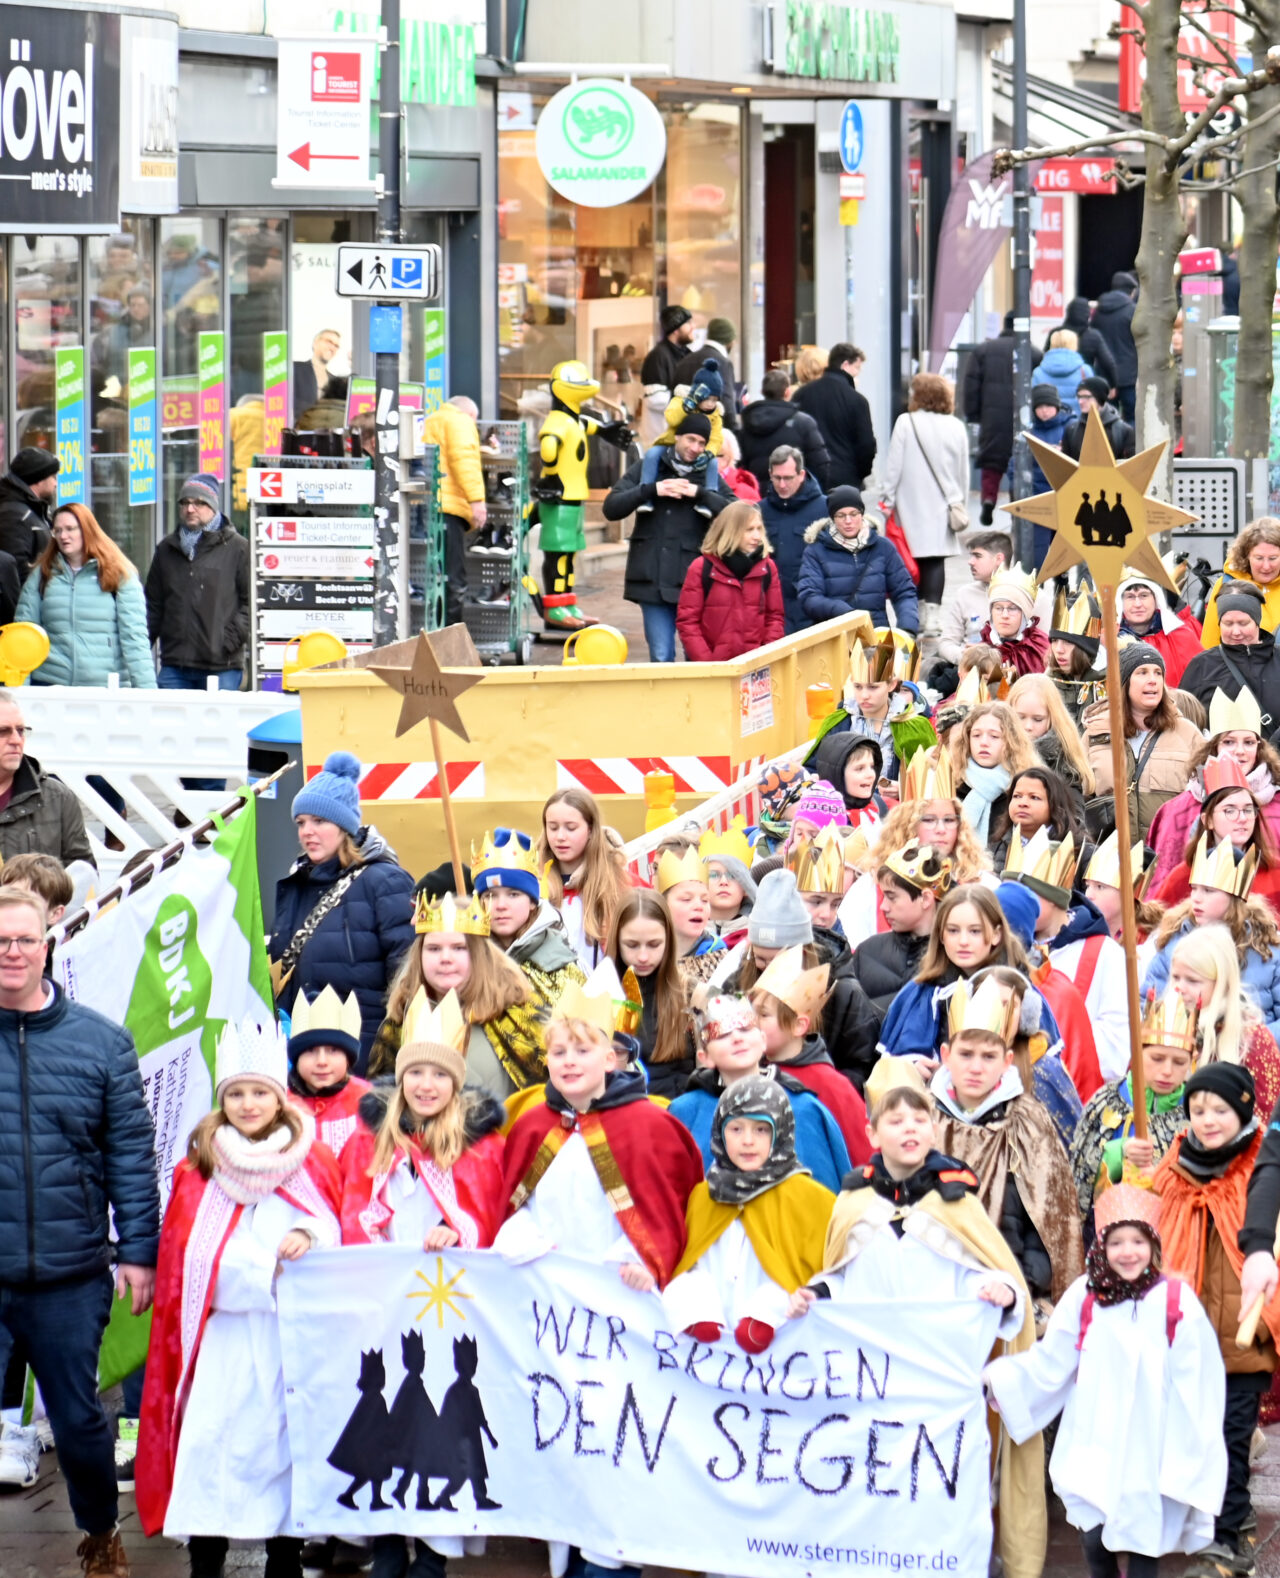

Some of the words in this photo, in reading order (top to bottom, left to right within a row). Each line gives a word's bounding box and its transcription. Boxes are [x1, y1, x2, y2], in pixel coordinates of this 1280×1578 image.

[0, 38, 93, 164] övel
[31, 169, 66, 192] men's
[67, 167, 93, 198] style
[551, 165, 646, 182] SALAMANDER
[401, 260, 416, 276] P
[200, 419, 223, 452] 50%
[59, 440, 83, 475] 50%
[130, 438, 155, 471] 50%
[297, 480, 352, 491] Königsplatz
[300, 533, 361, 543] Ticket-Center
[301, 520, 330, 530] Tourist
[305, 612, 345, 621] MEYER
[403, 676, 448, 697] Harth
[158, 910, 196, 1030] BDKJ
[533, 1300, 628, 1361] WIR
[653, 1329, 891, 1402] BRINGEN
[526, 1372, 678, 1474] DEN
[706, 1400, 966, 1503] SEGEN
[746, 1535, 959, 1573] www.sternsinger.de
